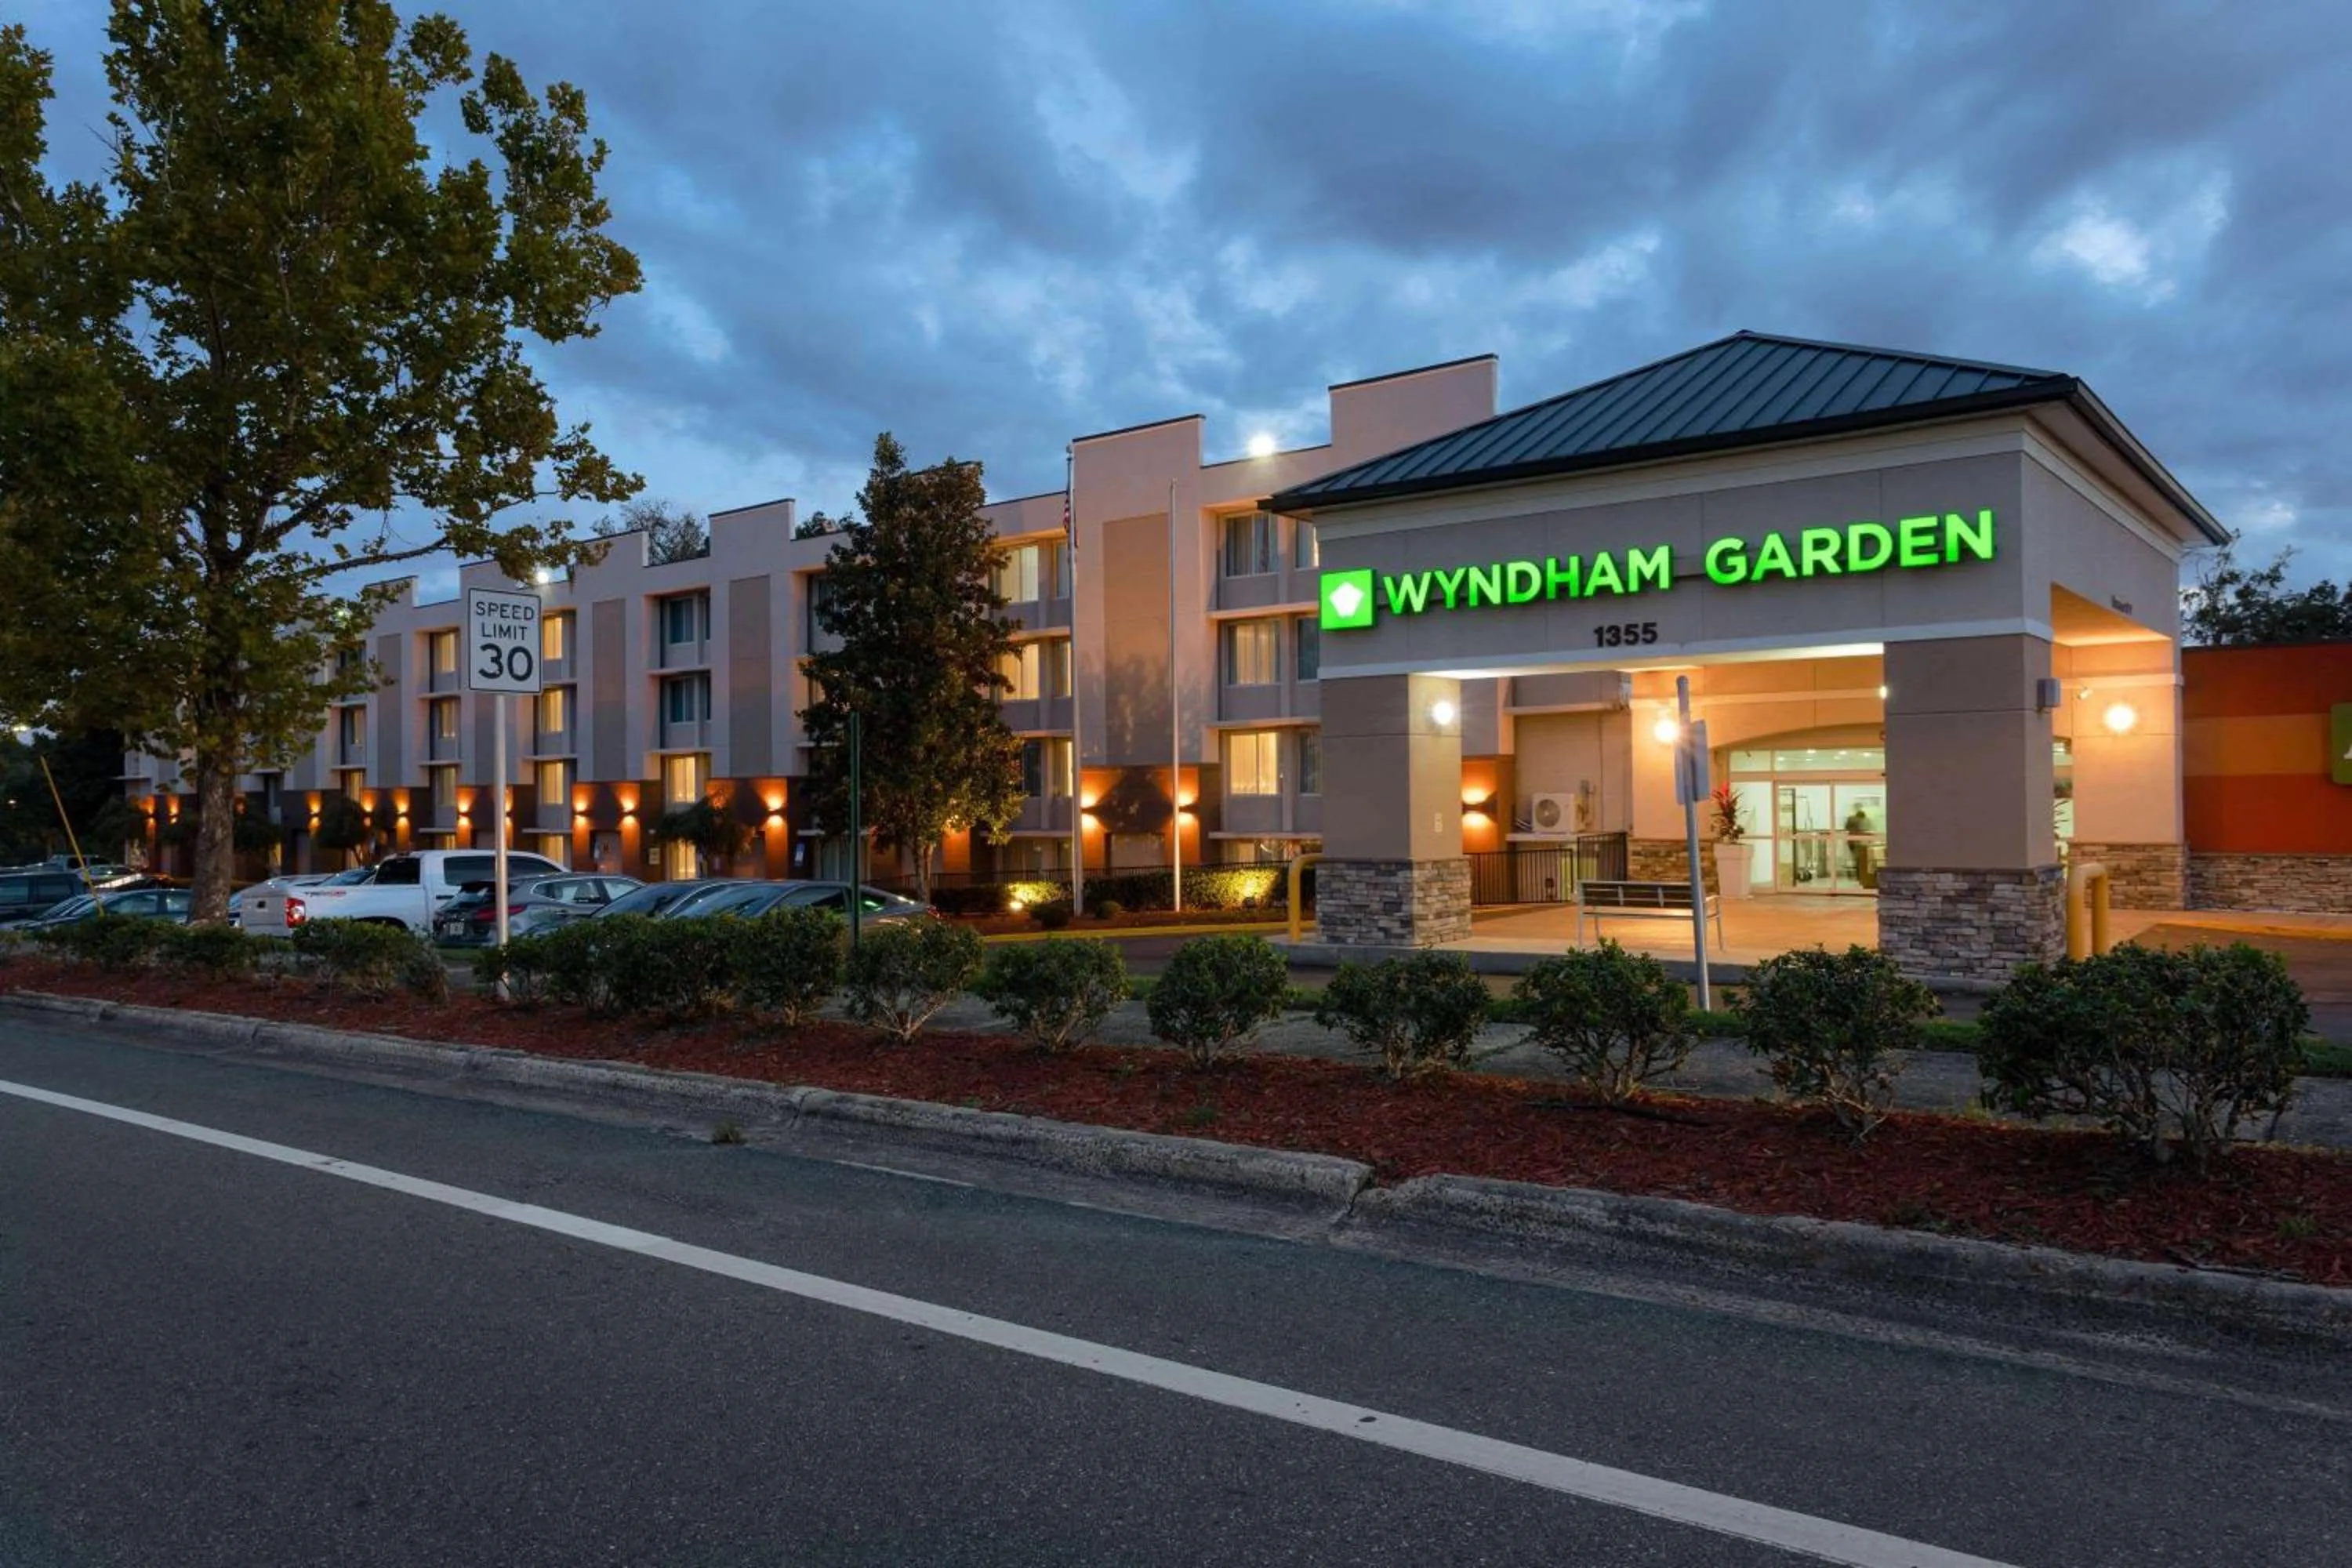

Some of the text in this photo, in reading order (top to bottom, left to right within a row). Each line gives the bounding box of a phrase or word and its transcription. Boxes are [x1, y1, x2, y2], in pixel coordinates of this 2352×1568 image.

[1382, 510, 1995, 615] WYNDHAM GARDEN
[476, 601, 535, 620] SPEED
[481, 622, 528, 641] LIMIT
[1594, 622, 1658, 648] 1355
[478, 643, 533, 681] 30
